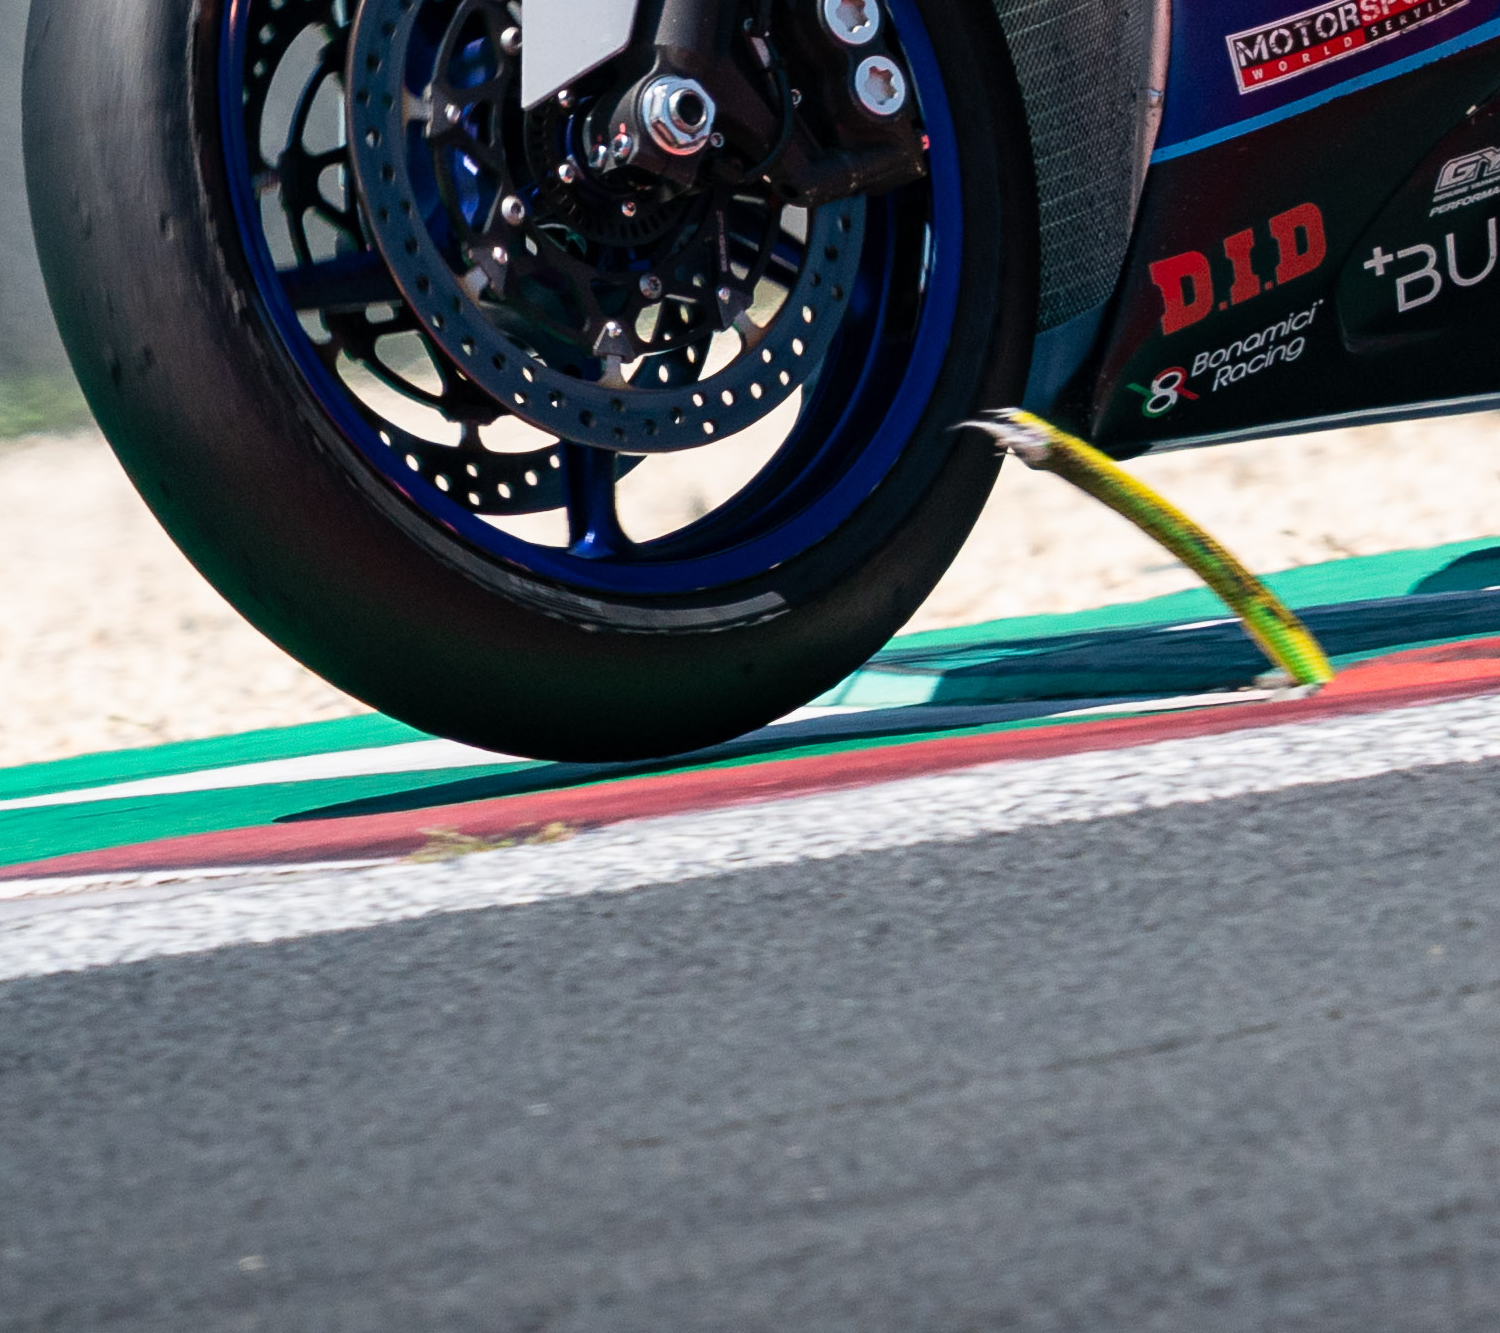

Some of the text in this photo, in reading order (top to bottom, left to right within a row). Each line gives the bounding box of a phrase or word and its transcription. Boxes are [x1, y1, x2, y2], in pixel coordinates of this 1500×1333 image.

[1251, 36, 1354, 81] WORLD
[1149, 202, 1327, 335] D.I.D
[1191, 302, 1318, 378] Bonamici
[1211, 336, 1306, 393] Racing
